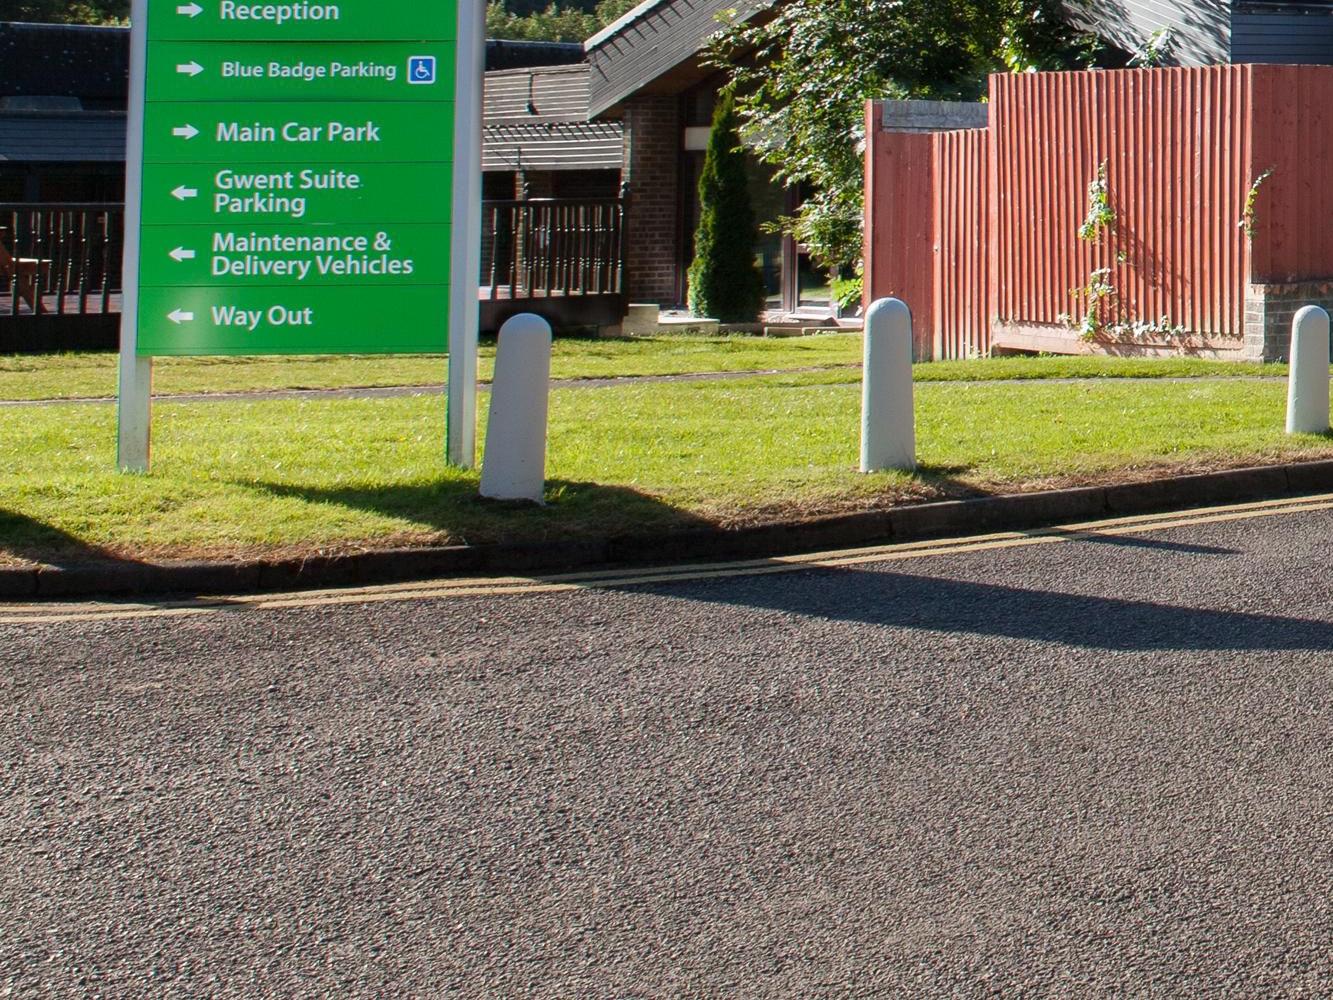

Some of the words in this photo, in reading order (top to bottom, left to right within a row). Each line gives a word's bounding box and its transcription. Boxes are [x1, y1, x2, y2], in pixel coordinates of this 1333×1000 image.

[220, 1, 339, 24] Reception
[222, 62, 262, 77] Blue
[268, 62, 326, 81] Badge
[330, 62, 396, 81] Parking
[216, 122, 275, 142] Main
[282, 123, 321, 142] Car
[328, 122, 380, 142] Park
[215, 170, 294, 190] Gwent
[300, 170, 359, 190] Suite
[214, 193, 305, 217] Parking
[212, 231, 368, 252] Maintenance
[373, 232, 391, 251] &
[211, 255, 312, 280] Delivery
[316, 255, 413, 275] Vehicles
[211, 305, 261, 331] Way
[267, 306, 312, 326] Out
